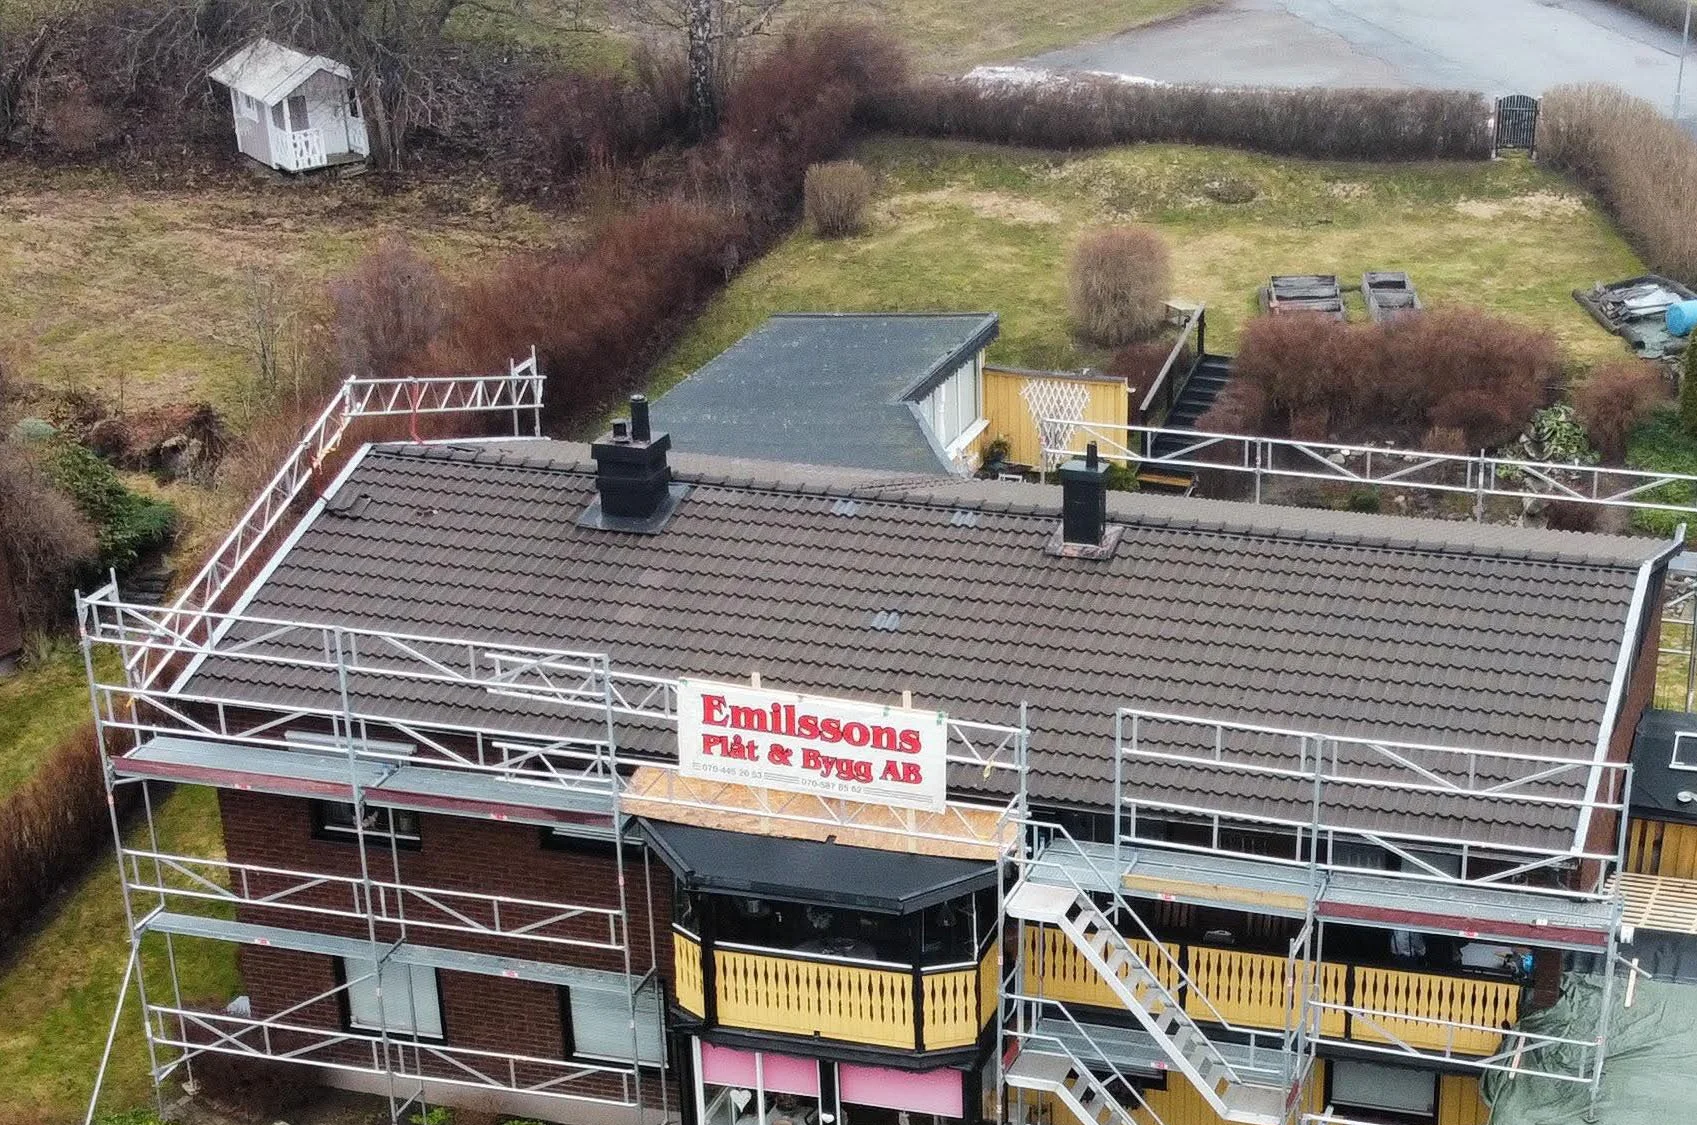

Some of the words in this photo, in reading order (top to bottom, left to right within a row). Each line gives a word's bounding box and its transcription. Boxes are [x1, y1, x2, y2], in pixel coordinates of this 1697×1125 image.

[701, 694, 922, 754] Emilssons
[702, 733, 759, 762] Plåt
[767, 743, 793, 766] &
[801, 748, 874, 783] Bygg
[880, 760, 923, 785] AB
